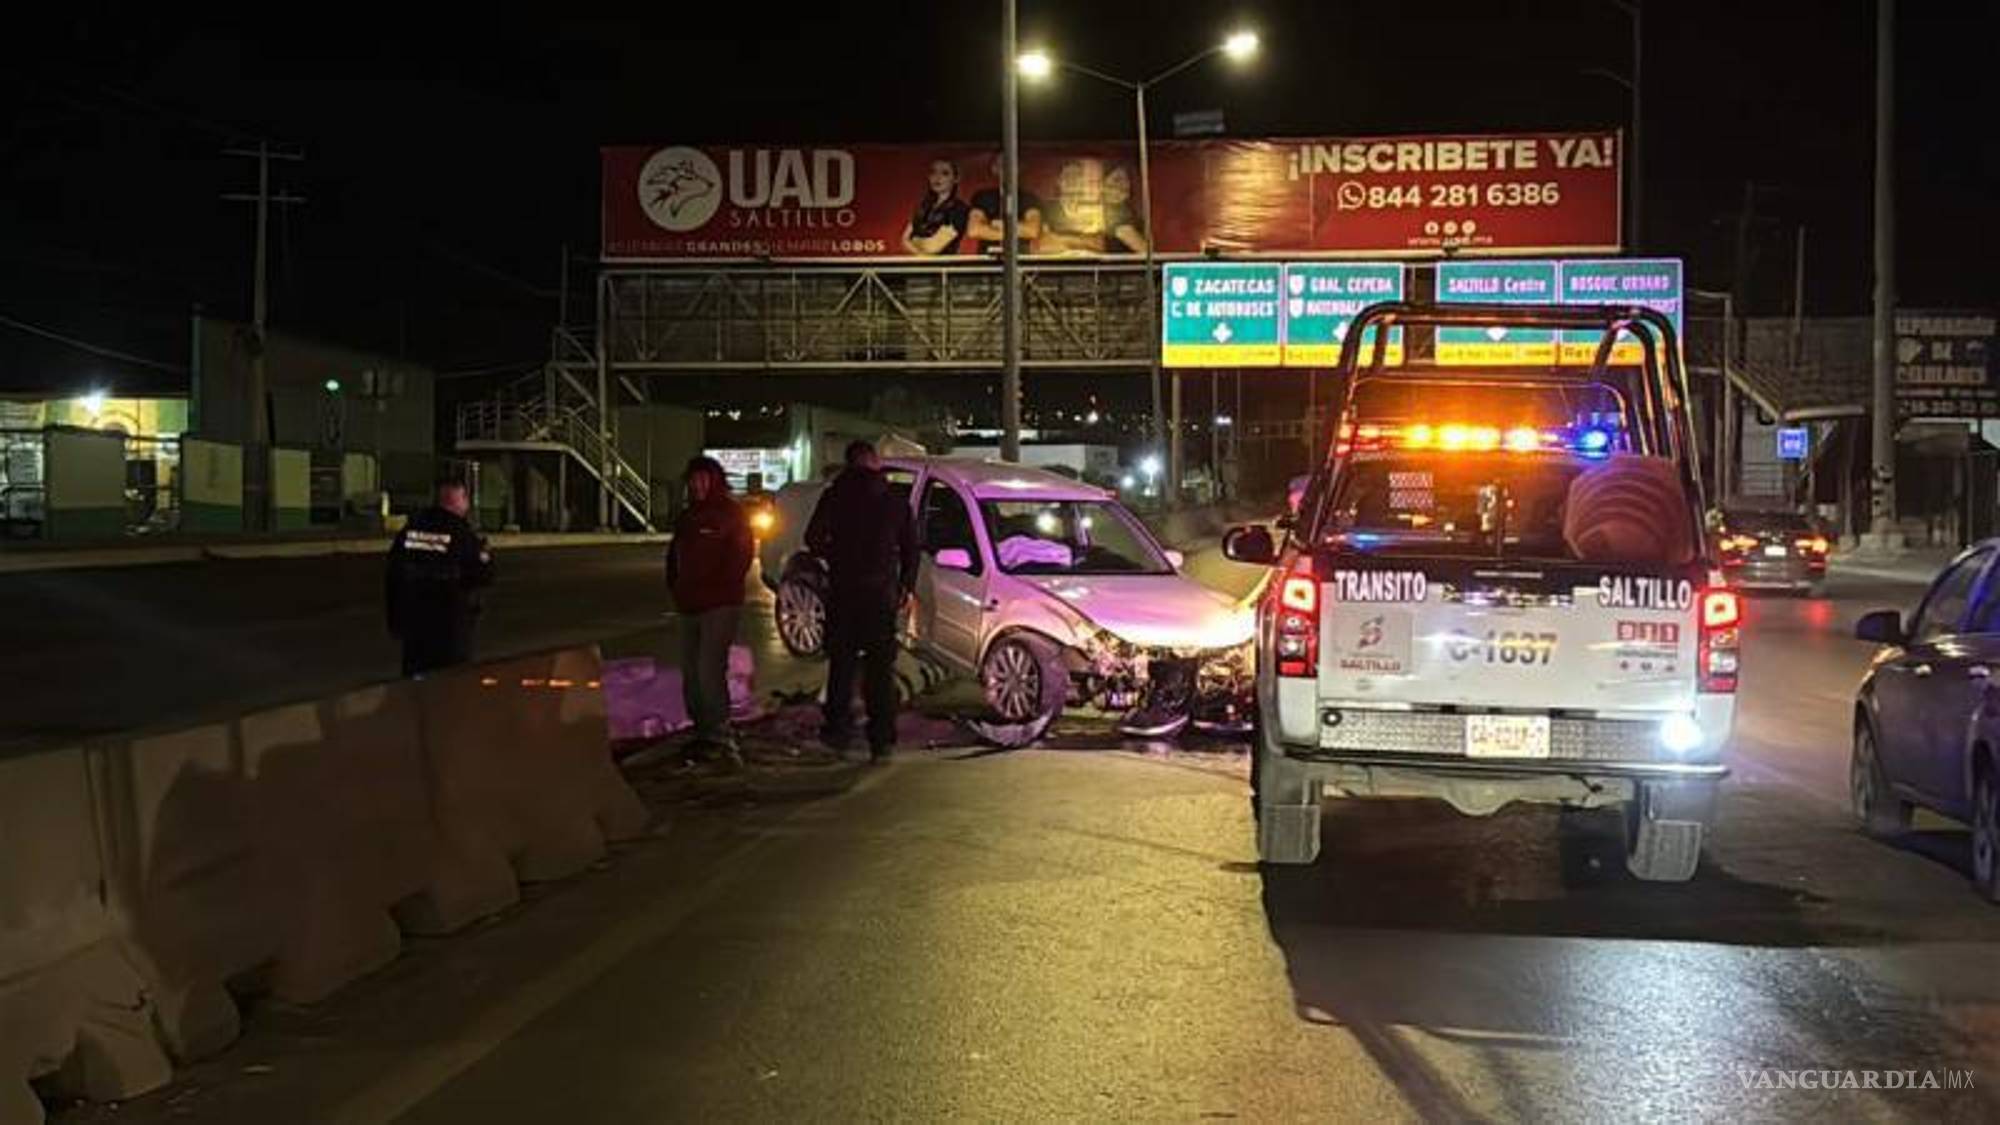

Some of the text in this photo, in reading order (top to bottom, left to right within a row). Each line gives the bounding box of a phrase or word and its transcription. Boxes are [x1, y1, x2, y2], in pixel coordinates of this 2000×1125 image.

[1288, 137, 1613, 181] ¡INSCRIBETE YA!
[729, 149, 854, 208] UAD
[1368, 182, 1560, 208] 844 281 6386
[730, 208, 856, 228] SALTILLO
[1195, 279, 1274, 294] ZACATECAS
[1335, 571, 1692, 610] TRANSITO SALTILLO
[1450, 629, 1558, 664] C-1637
